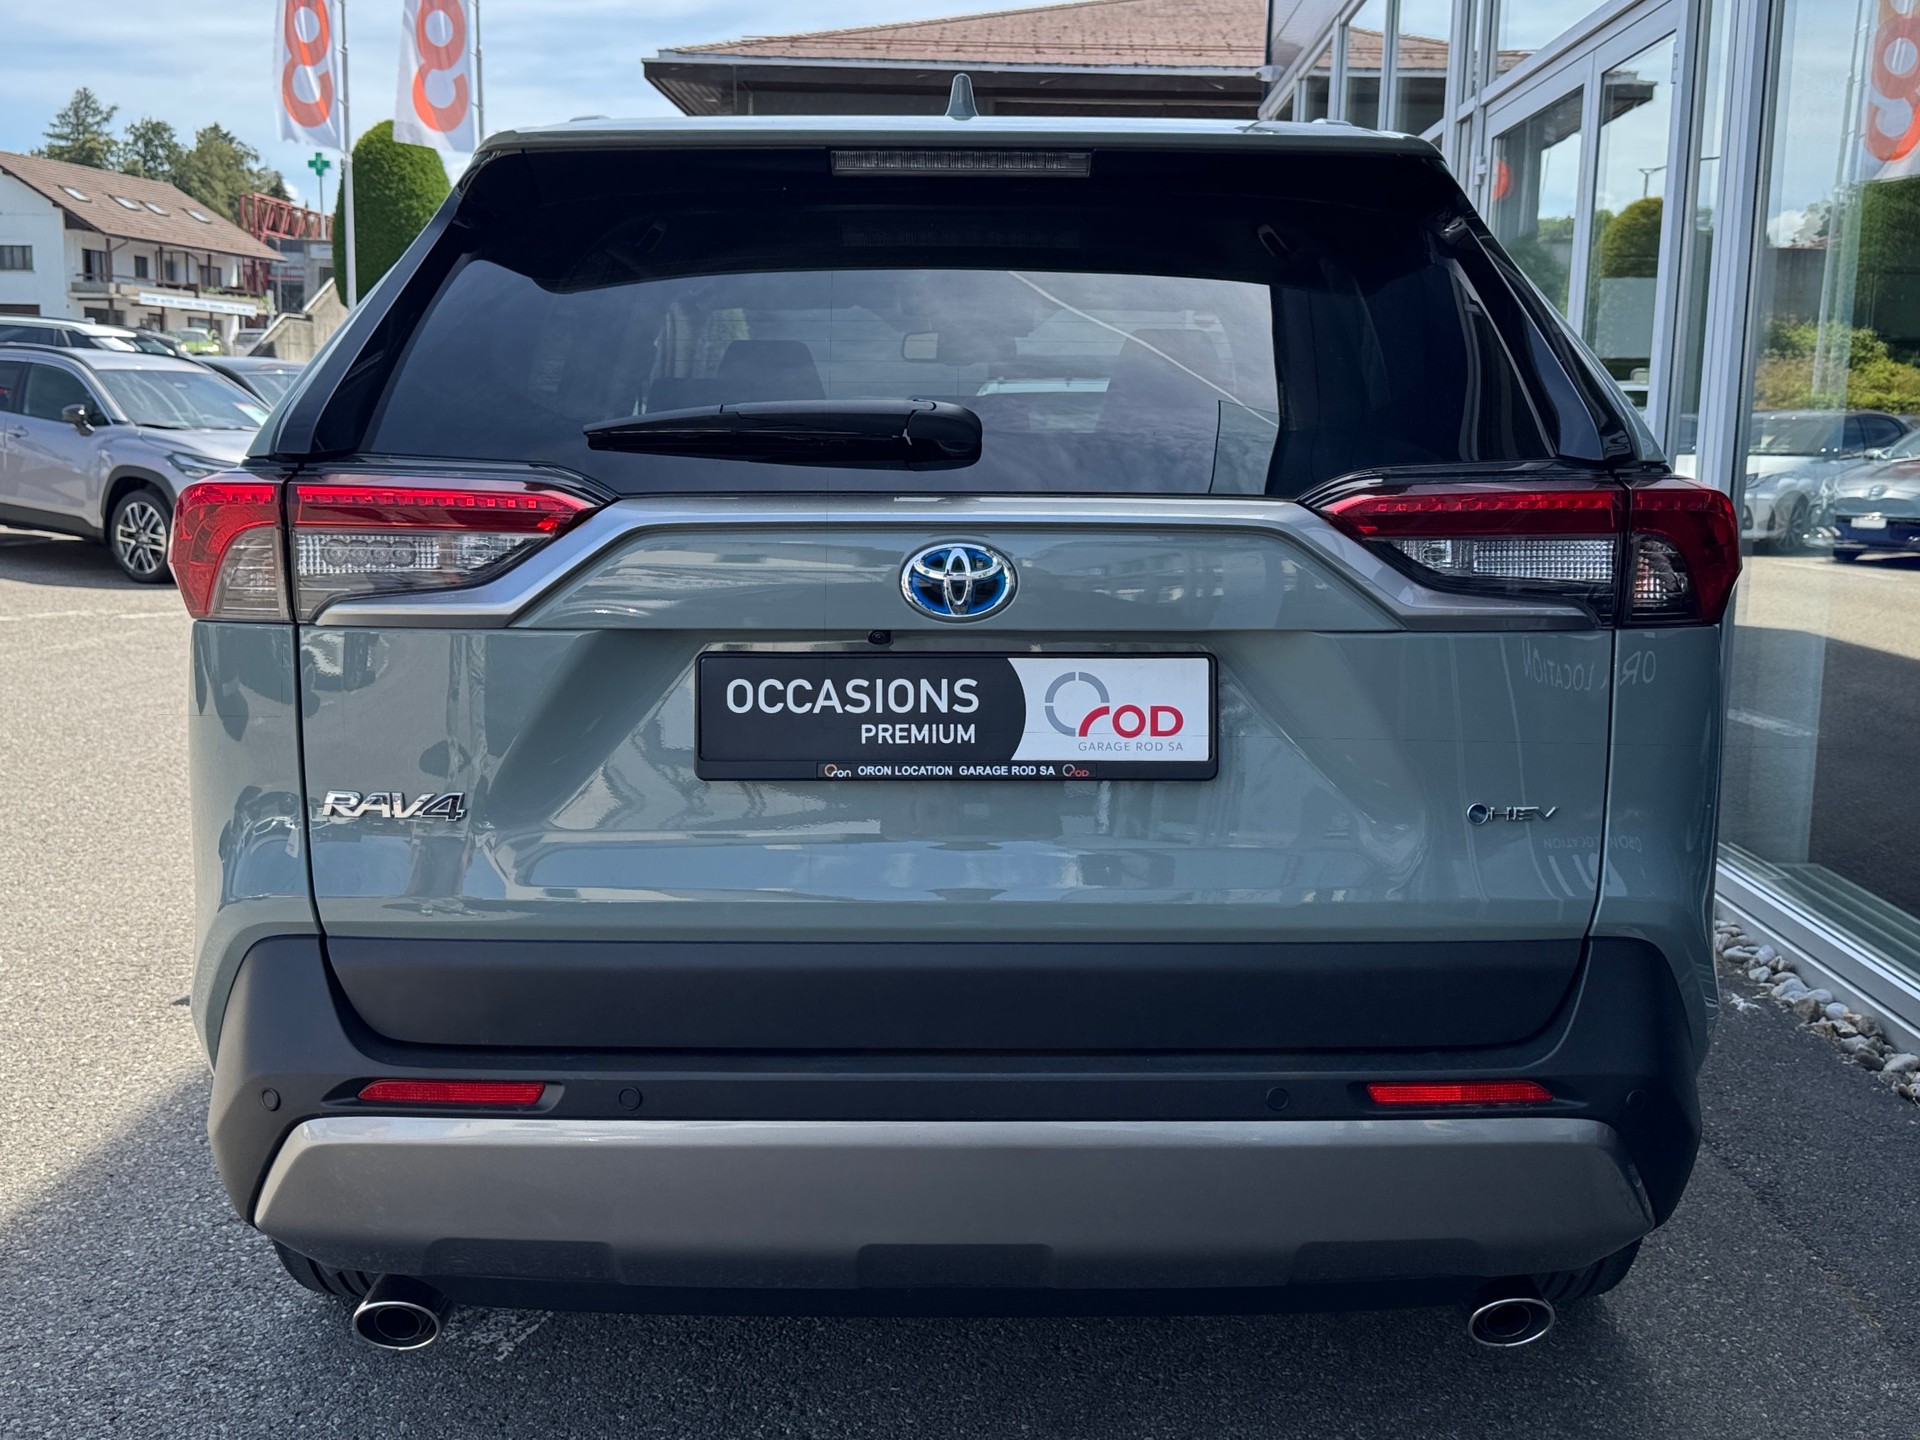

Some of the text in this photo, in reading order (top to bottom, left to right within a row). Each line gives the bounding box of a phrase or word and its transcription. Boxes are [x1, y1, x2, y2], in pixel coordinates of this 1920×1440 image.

[726, 678, 980, 714] OCCASIONS
[861, 723, 976, 744] PREMIUM
[1078, 741, 1184, 751] GARAGE ROD SA
[857, 765, 892, 776] ORON
[894, 765, 953, 776] LOCATION
[958, 765, 1009, 776] GARAGE
[1011, 765, 1037, 776] ROD
[1039, 765, 1056, 776] SA
[322, 790, 467, 822] RAV4
[1488, 805, 1558, 821] HEV
